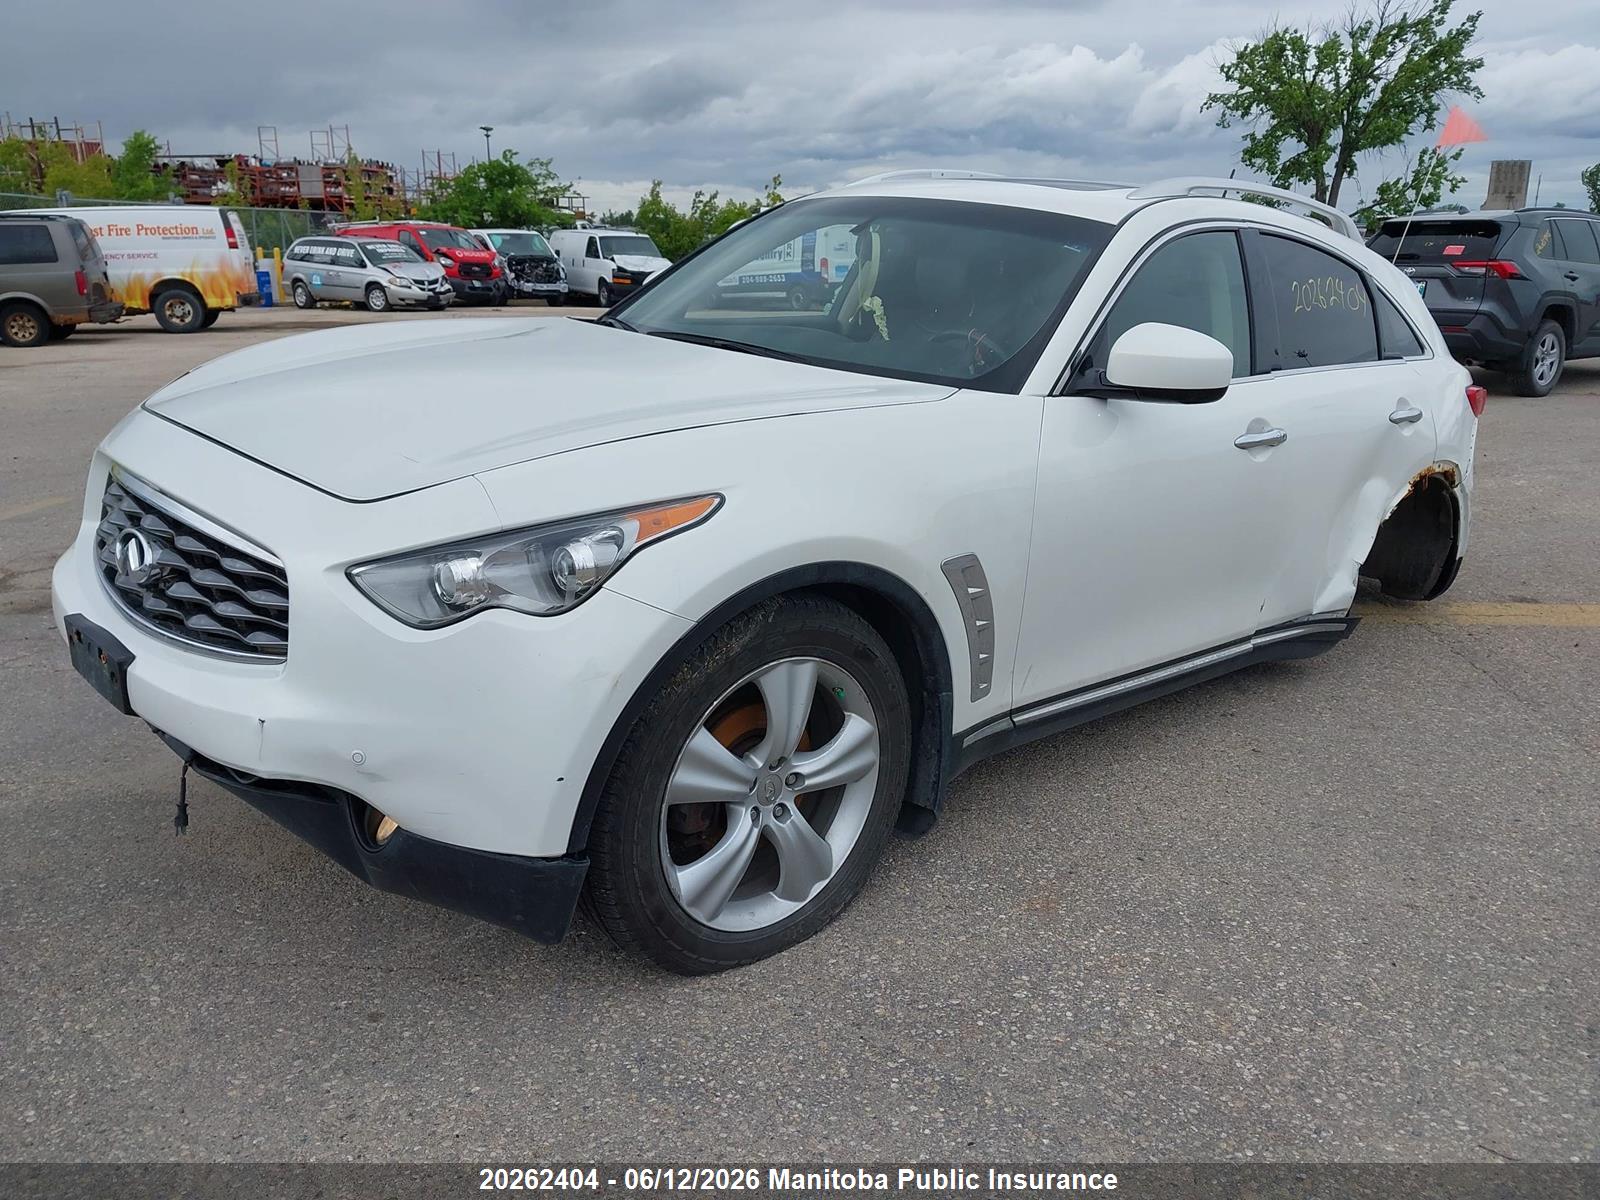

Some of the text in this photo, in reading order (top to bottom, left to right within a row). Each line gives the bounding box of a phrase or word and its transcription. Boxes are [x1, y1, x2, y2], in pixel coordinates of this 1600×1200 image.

[107, 224, 131, 237] Fire
[136, 223, 198, 236] Protection
[127, 252, 158, 260] SERVICE
